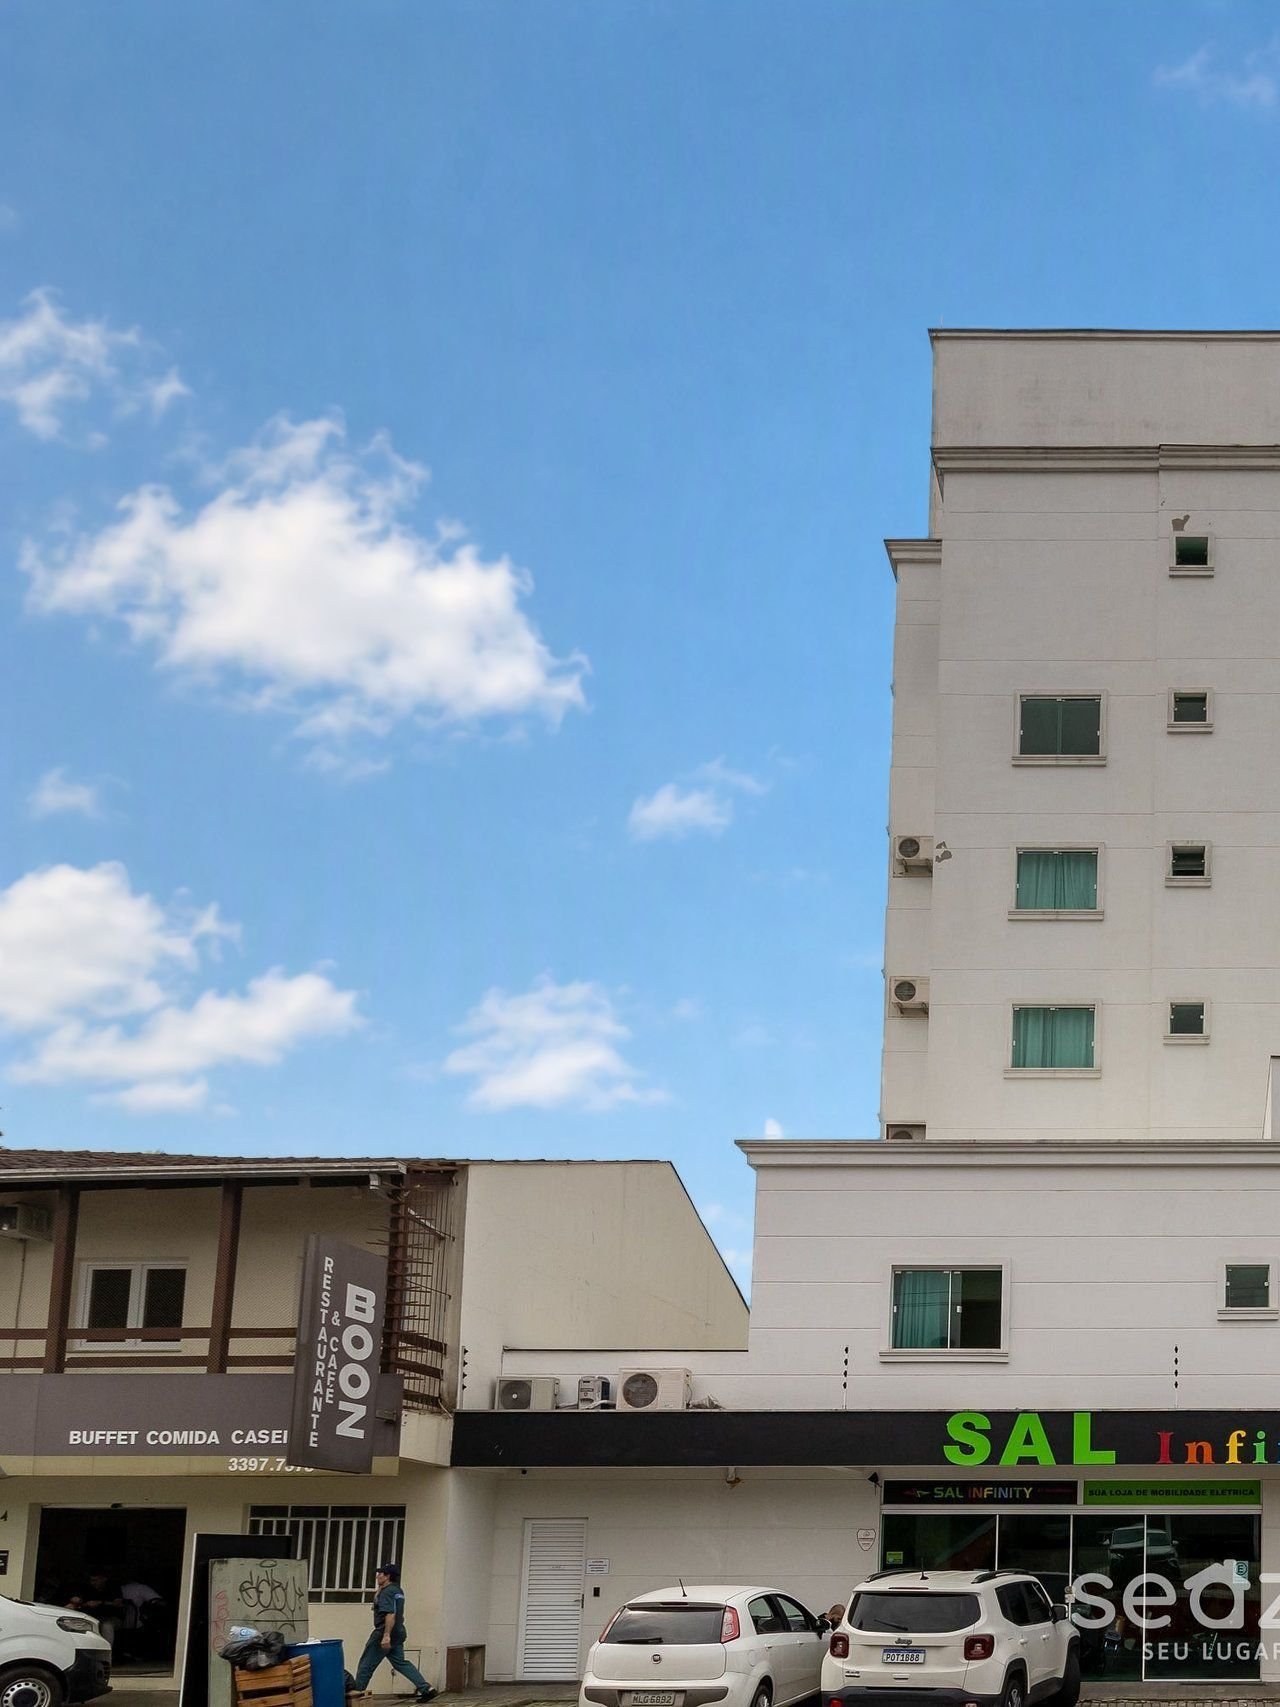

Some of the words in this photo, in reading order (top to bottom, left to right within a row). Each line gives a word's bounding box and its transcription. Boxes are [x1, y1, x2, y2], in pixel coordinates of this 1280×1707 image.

[309, 1256, 335, 1448] RESTAURANTE
[335, 1282, 376, 1440] BOOZ
[69, 1430, 139, 1445] BUFFET
[146, 1430, 220, 1445] COMIDA
[231, 1429, 289, 1444] CASEI
[943, 1412, 1117, 1466] SAL
[228, 1457, 315, 1471] 3397.7
[934, 1487, 964, 1498] SAL
[968, 1487, 1033, 1499] INFINITY
[1088, 1489, 1107, 1497] SUA
[1110, 1489, 1133, 1497] LOJA
[1151, 1489, 1207, 1497] MOBILIDADE
